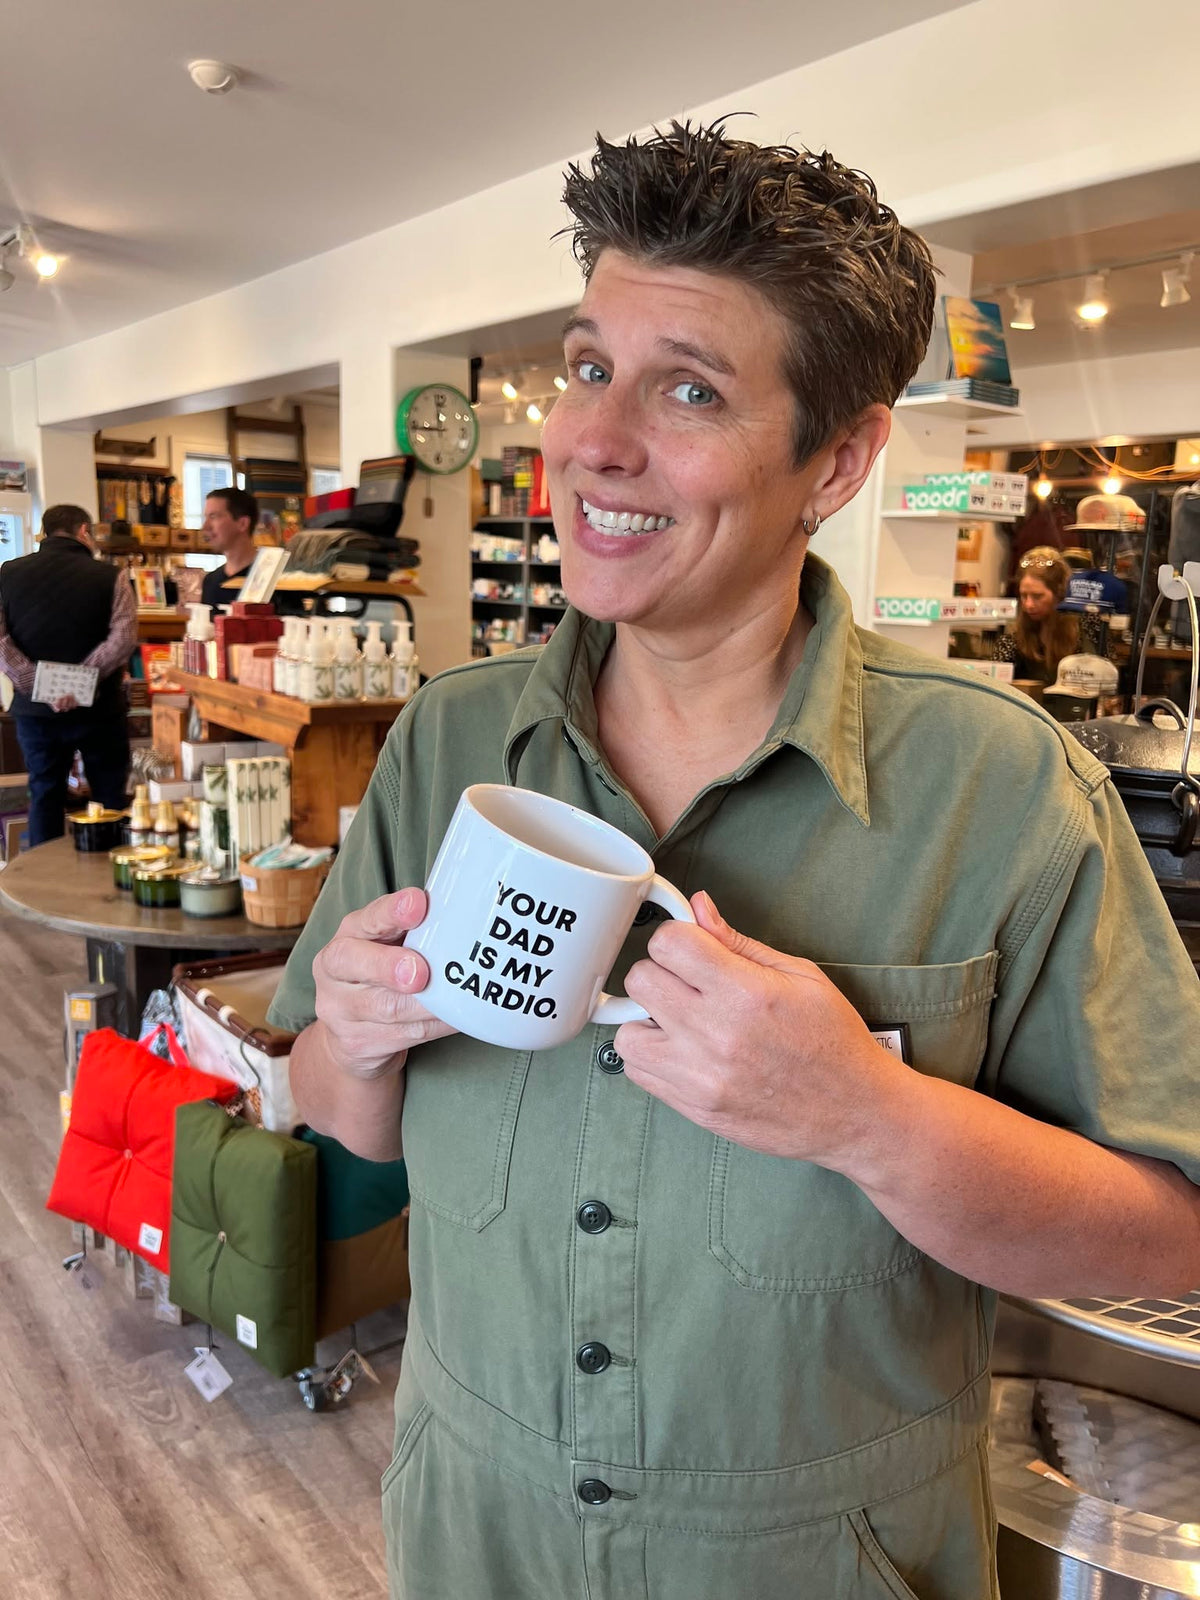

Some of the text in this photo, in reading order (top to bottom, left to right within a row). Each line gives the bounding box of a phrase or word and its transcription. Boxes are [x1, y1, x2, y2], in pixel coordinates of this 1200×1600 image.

[497, 880, 577, 933] YOUR
[488, 915, 555, 957] DAD
[468, 940, 554, 988] IS MY
[444, 960, 558, 1020] CARDIO.
